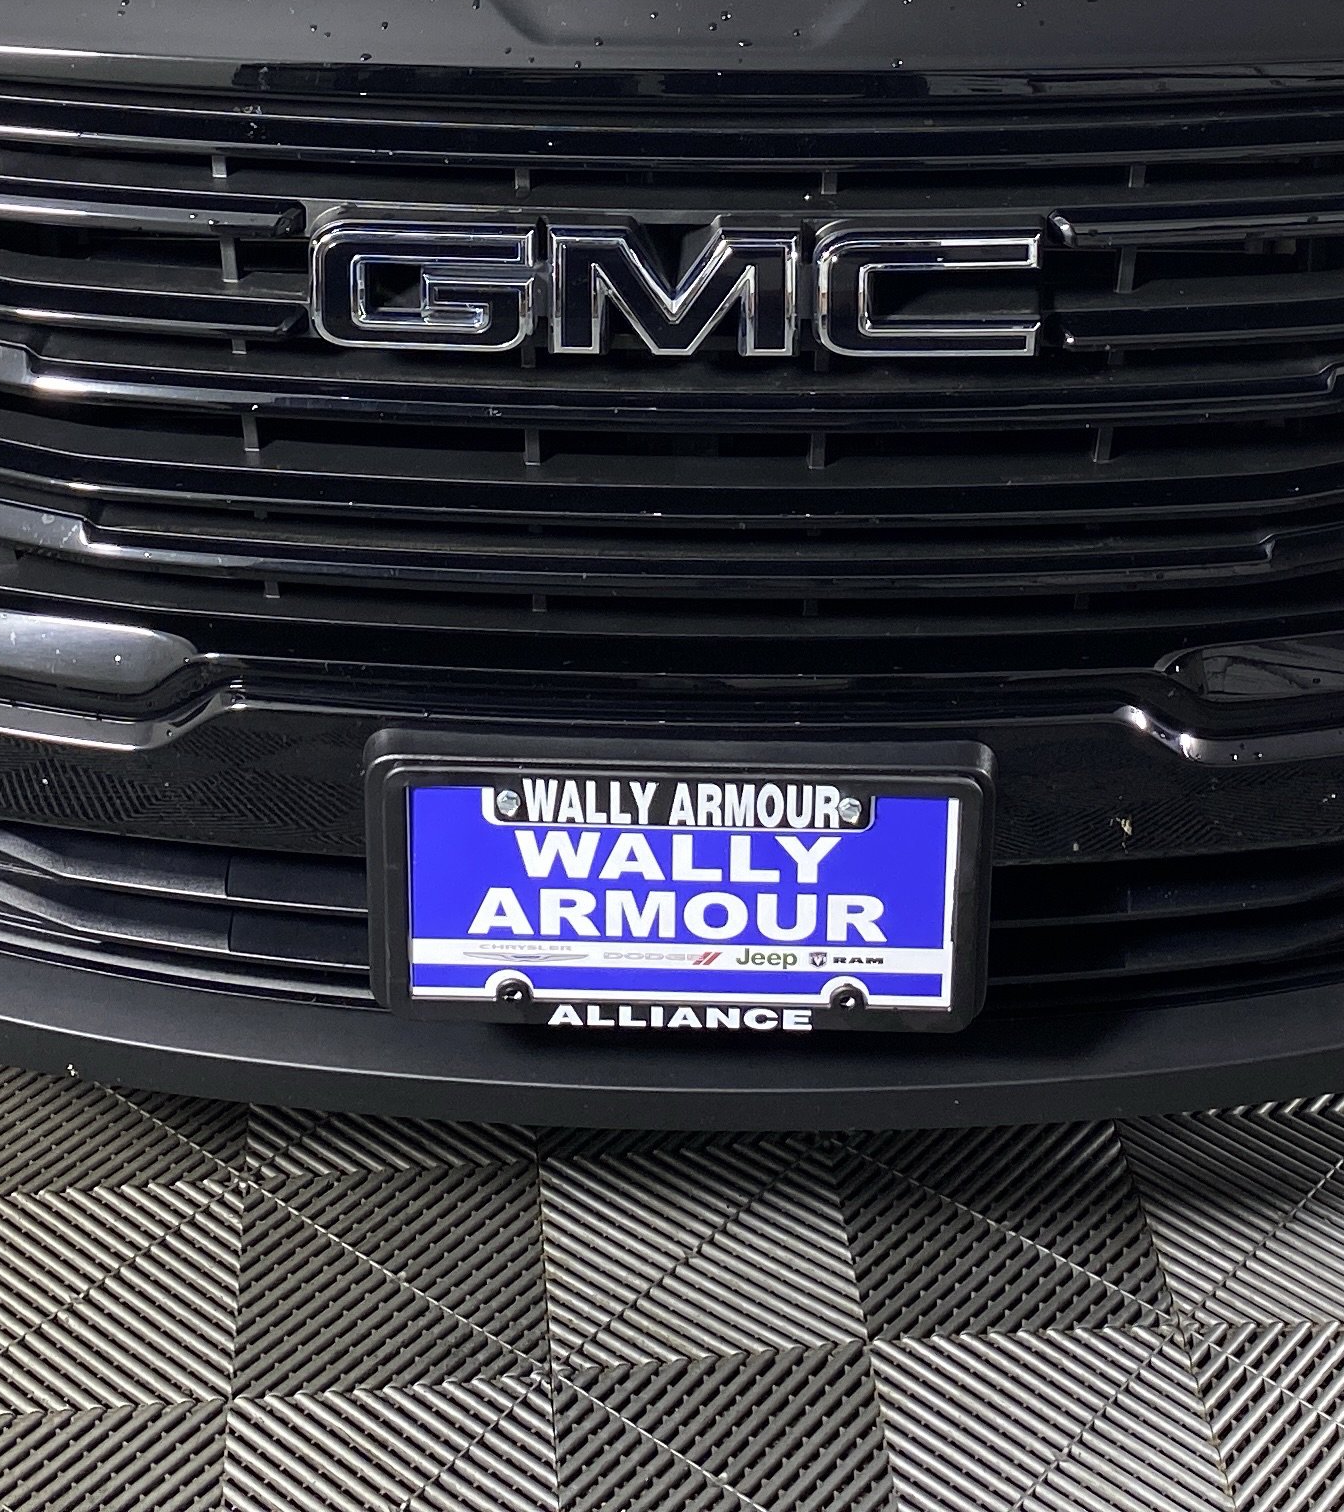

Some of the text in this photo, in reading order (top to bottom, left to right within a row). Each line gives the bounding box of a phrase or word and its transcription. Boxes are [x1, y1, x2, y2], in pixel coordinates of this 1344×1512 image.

[308, 218, 1042, 357] GMC
[522, 778, 842, 829] WALLY ARMOUR
[514, 829, 843, 884] WALLY
[467, 887, 888, 943] ARMOUR
[479, 943, 572, 952] CHRYSLER
[603, 951, 704, 962] DODGE
[735, 947, 798, 969] Jeep
[832, 956, 884, 965] RAM
[547, 1003, 813, 1031] ALLIANCE
